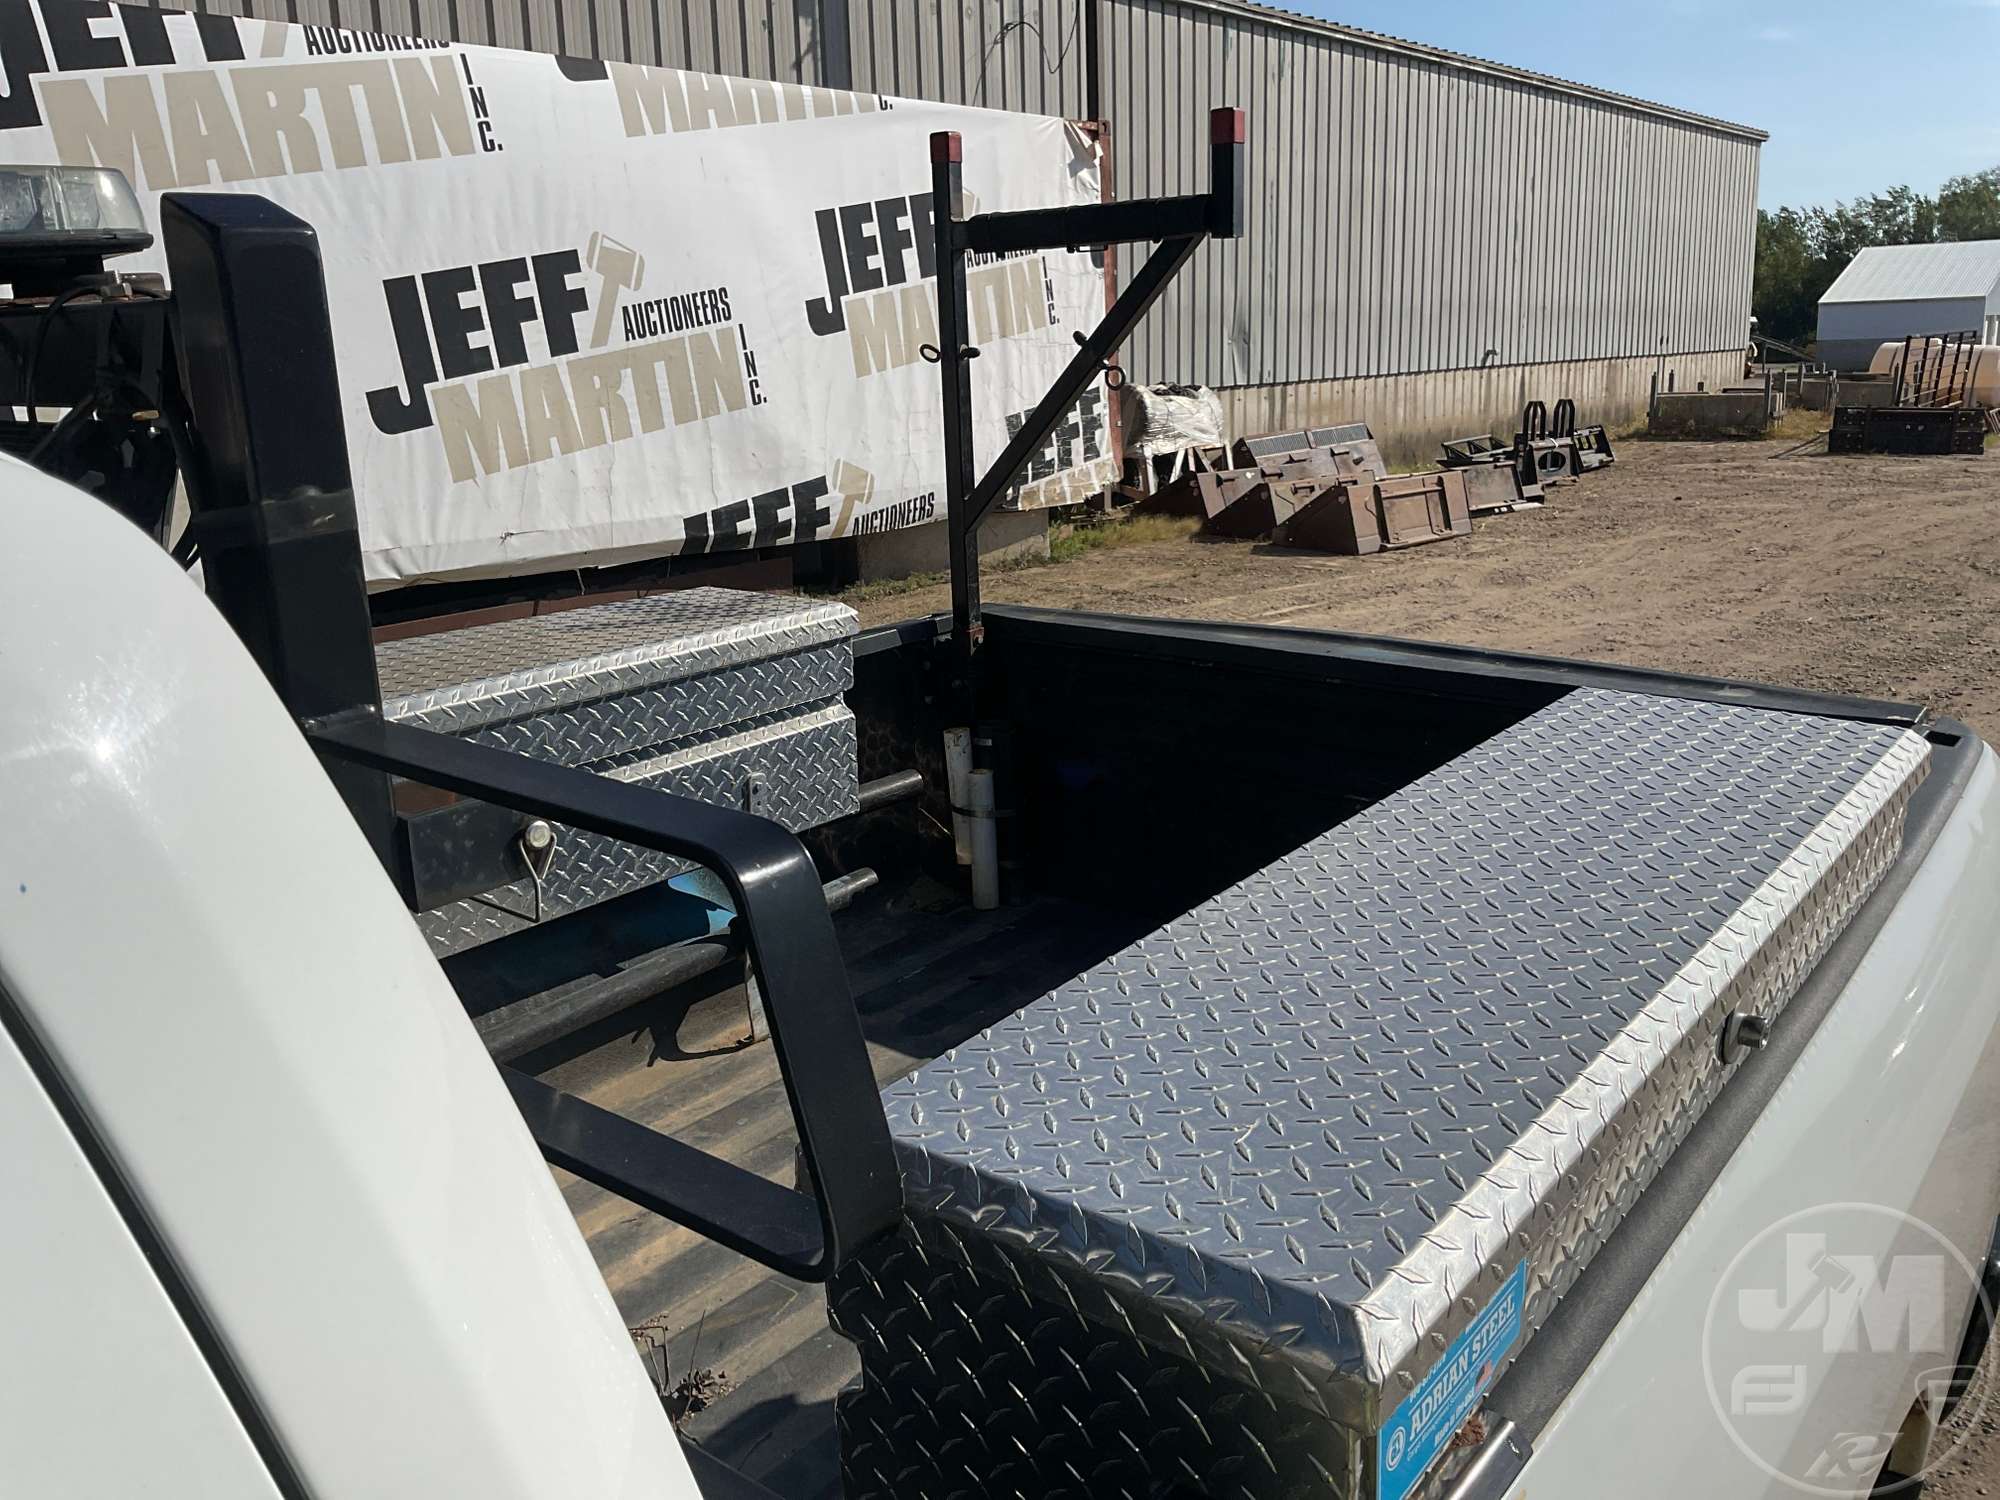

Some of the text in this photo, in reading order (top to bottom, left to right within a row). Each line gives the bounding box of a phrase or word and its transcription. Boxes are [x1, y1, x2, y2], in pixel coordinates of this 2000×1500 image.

[39, 55, 476, 192] MARTIN
[459, 53, 504, 153] INC.
[365, 249, 589, 435] JEFF
[622, 286, 732, 342] AUCTIONEERS
[738, 323, 768, 405] INC.
[844, 257, 1047, 379] MATIN
[431, 326, 748, 484] MARTIN
[1409, 1347, 1470, 1442] ADRIAN
[1471, 1295, 1516, 1362] STEEL
